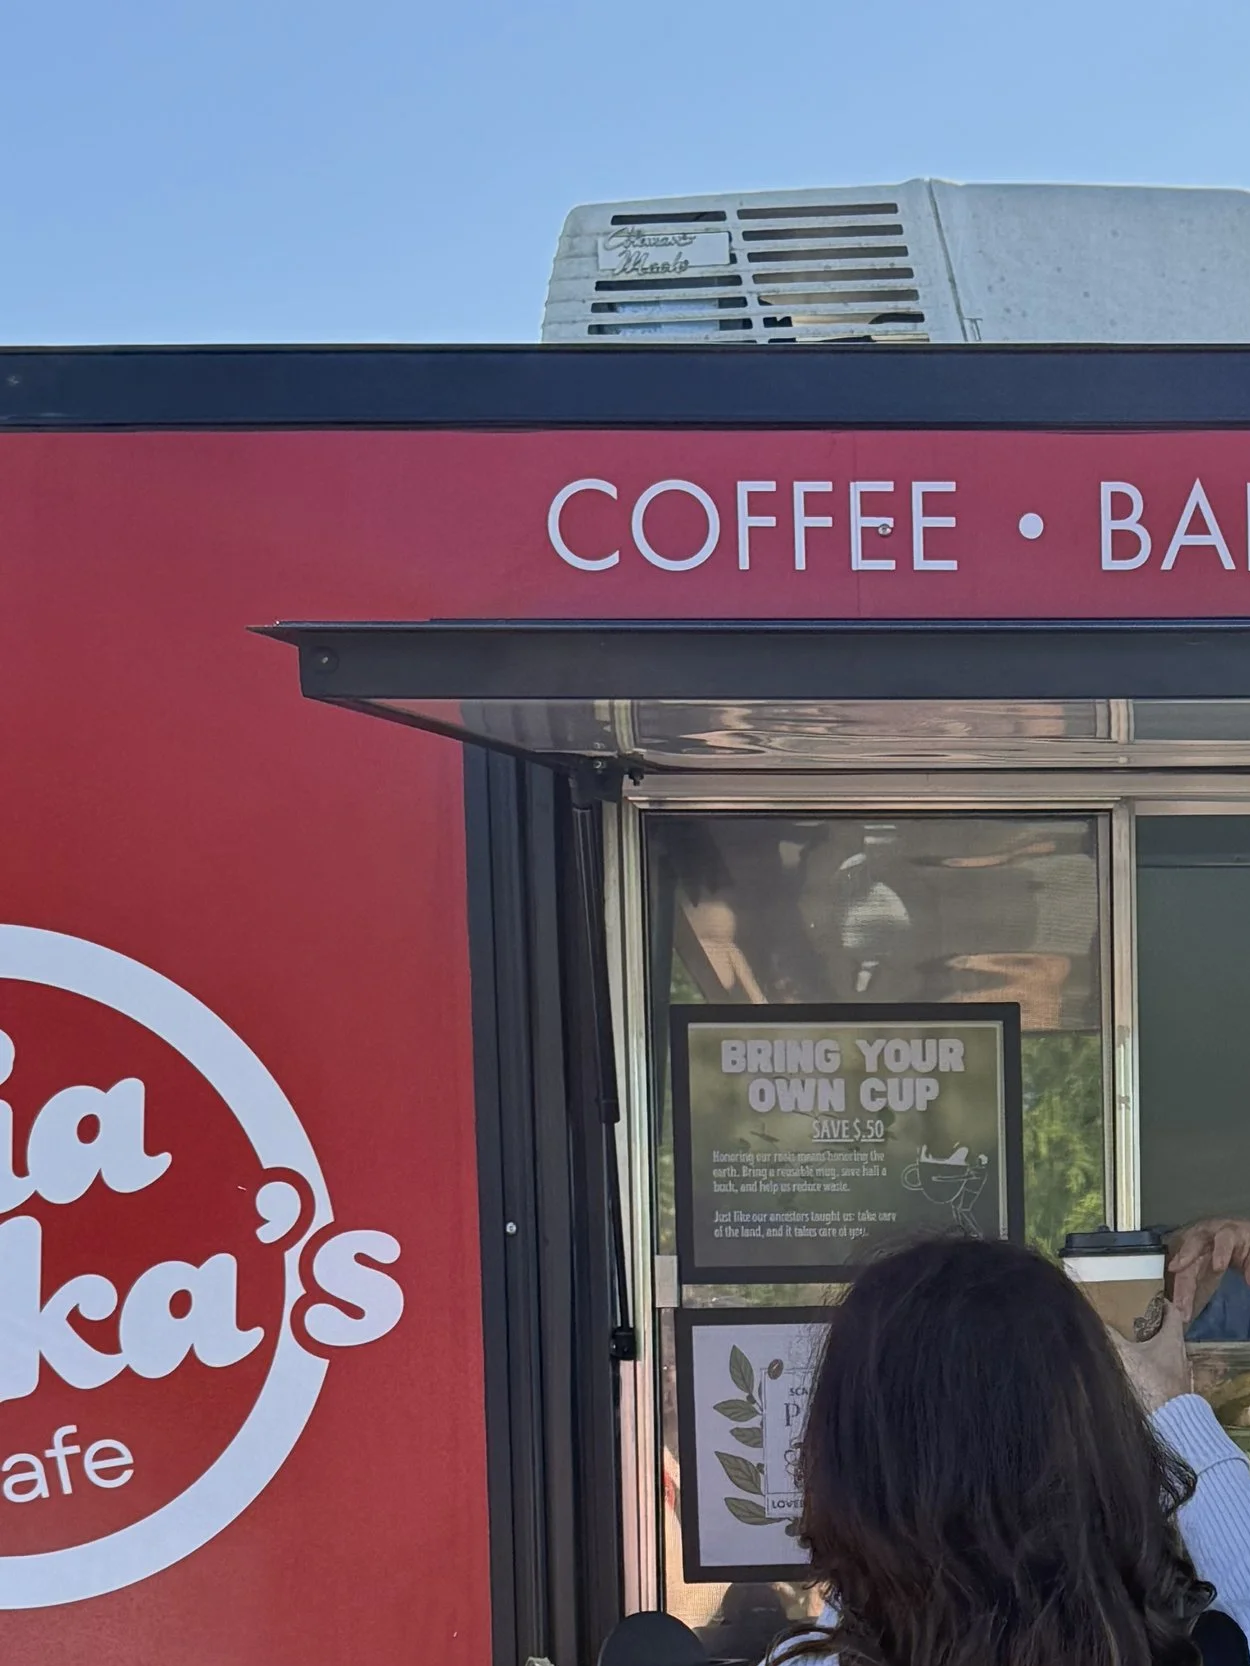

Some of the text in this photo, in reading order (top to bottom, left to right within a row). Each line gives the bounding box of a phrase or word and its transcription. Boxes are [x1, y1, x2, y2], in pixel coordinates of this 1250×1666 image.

[548, 479, 958, 571] COFFEE
[721, 1037, 965, 1074] BRING YOUR
[748, 1077, 940, 1113] OWN CUP
[812, 1118, 885, 1141] SAVE $.50
[712, 1150, 755, 1166] Honoring
[756, 1153, 772, 1162] our
[827, 1150, 868, 1165] honoring
[869, 1150, 884, 1163] the
[742, 1165, 768, 1181] Bring
[769, 1169, 775, 1178] a
[776, 1165, 814, 1178] reusable
[840, 1168, 861, 1178] save
[881, 1168, 888, 1178] a
[740, 1180, 758, 1193] and
[759, 1180, 779, 1195] help
[781, 1183, 792, 1193] us
[792, 1180, 822, 1193] reduce
[714, 1210, 732, 1223] Just
[733, 1210, 751, 1223] like
[752, 1212, 768, 1223] our
[769, 1211, 810, 1223] ancestors
[811, 1210, 841, 1225] taught
[857, 1210, 877, 1223] take
[878, 1212, 897, 1223] care
[714, 1225, 724, 1238] of
[724, 1225, 740, 1238] the
[741, 1225, 765, 1240] land,
[766, 1225, 783, 1238] and
[785, 1225, 793, 1238] it
[794, 1226, 818, 1238] takes
[818, 1228, 837, 1238] care
[838, 1226, 847, 1238] of
